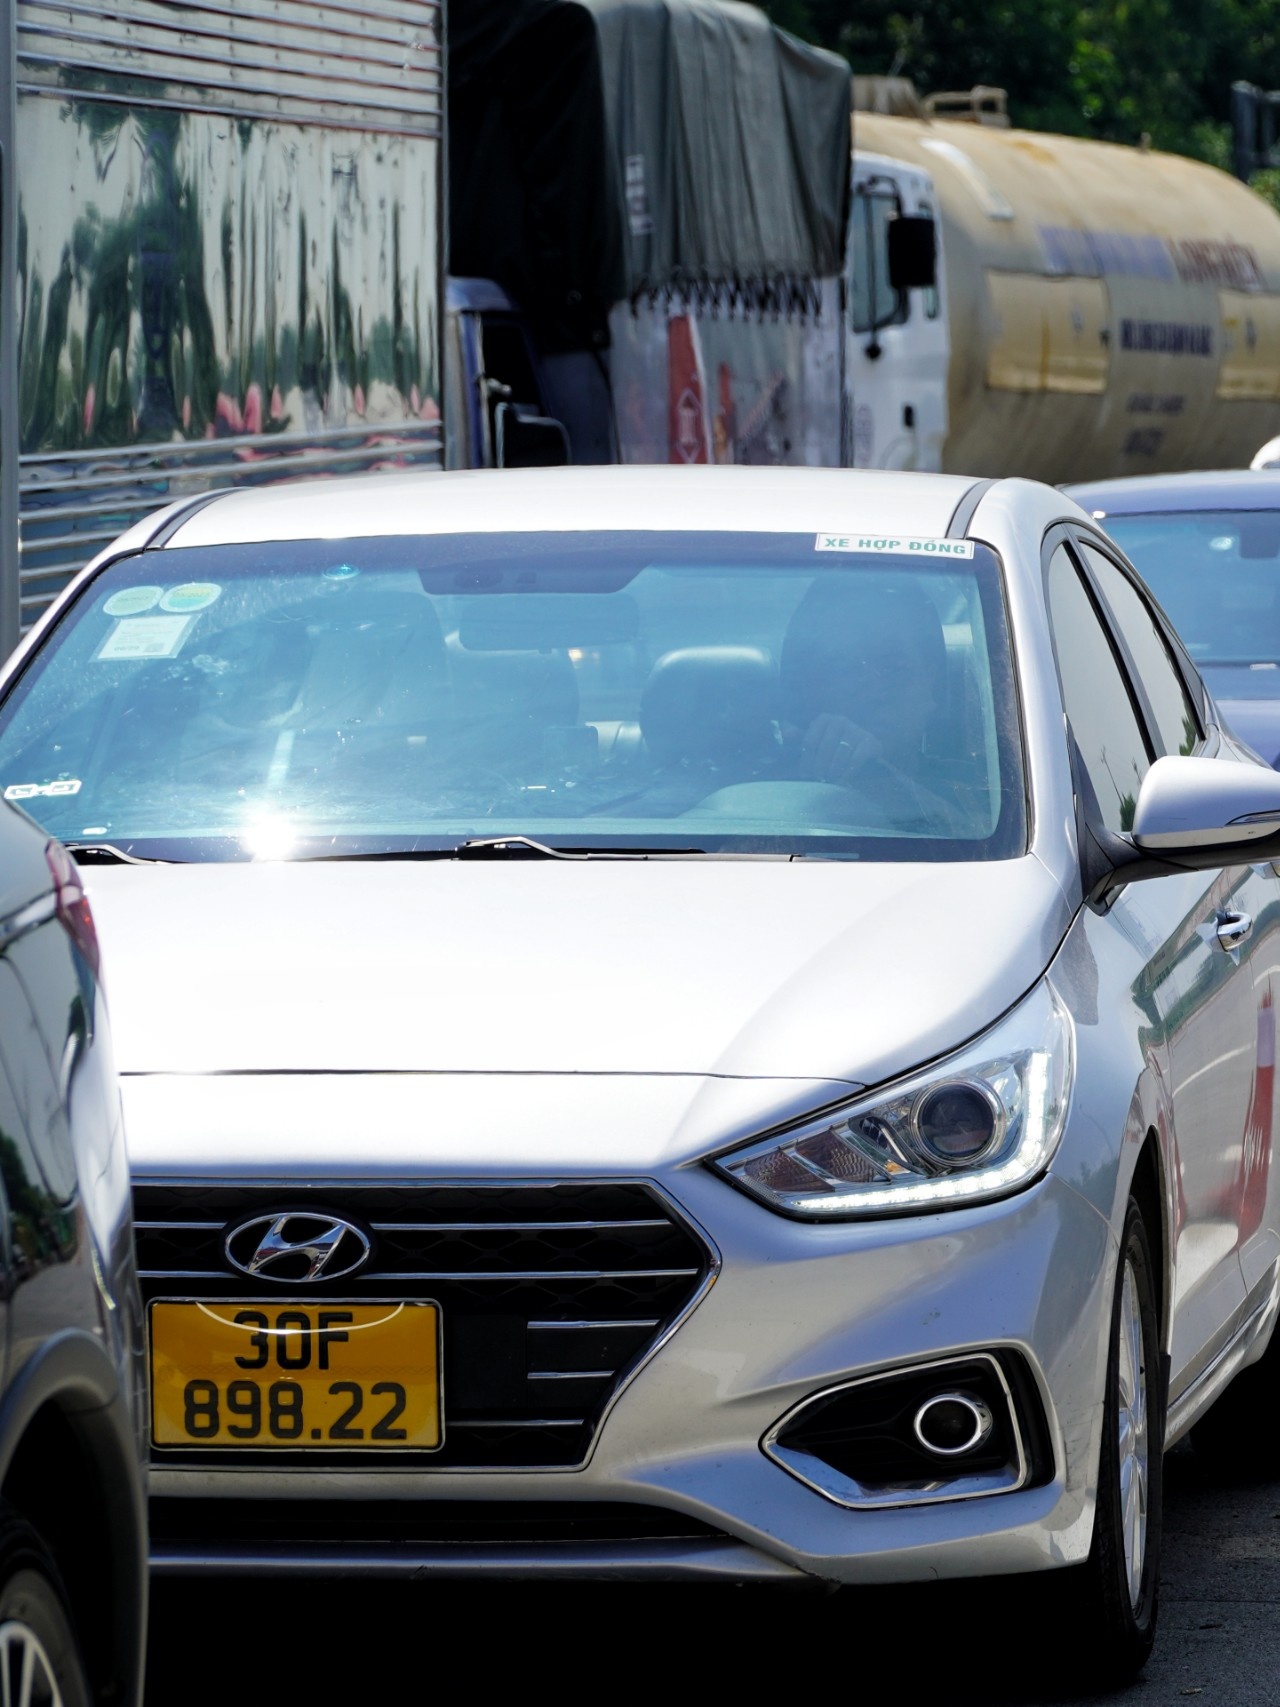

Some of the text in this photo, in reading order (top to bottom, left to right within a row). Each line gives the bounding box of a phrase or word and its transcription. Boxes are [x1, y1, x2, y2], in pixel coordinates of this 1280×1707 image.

[825, 538, 850, 548] XE
[858, 539, 901, 551] HỢP
[233, 1311, 354, 1370] 30F
[183, 1379, 408, 1440] 898.22
